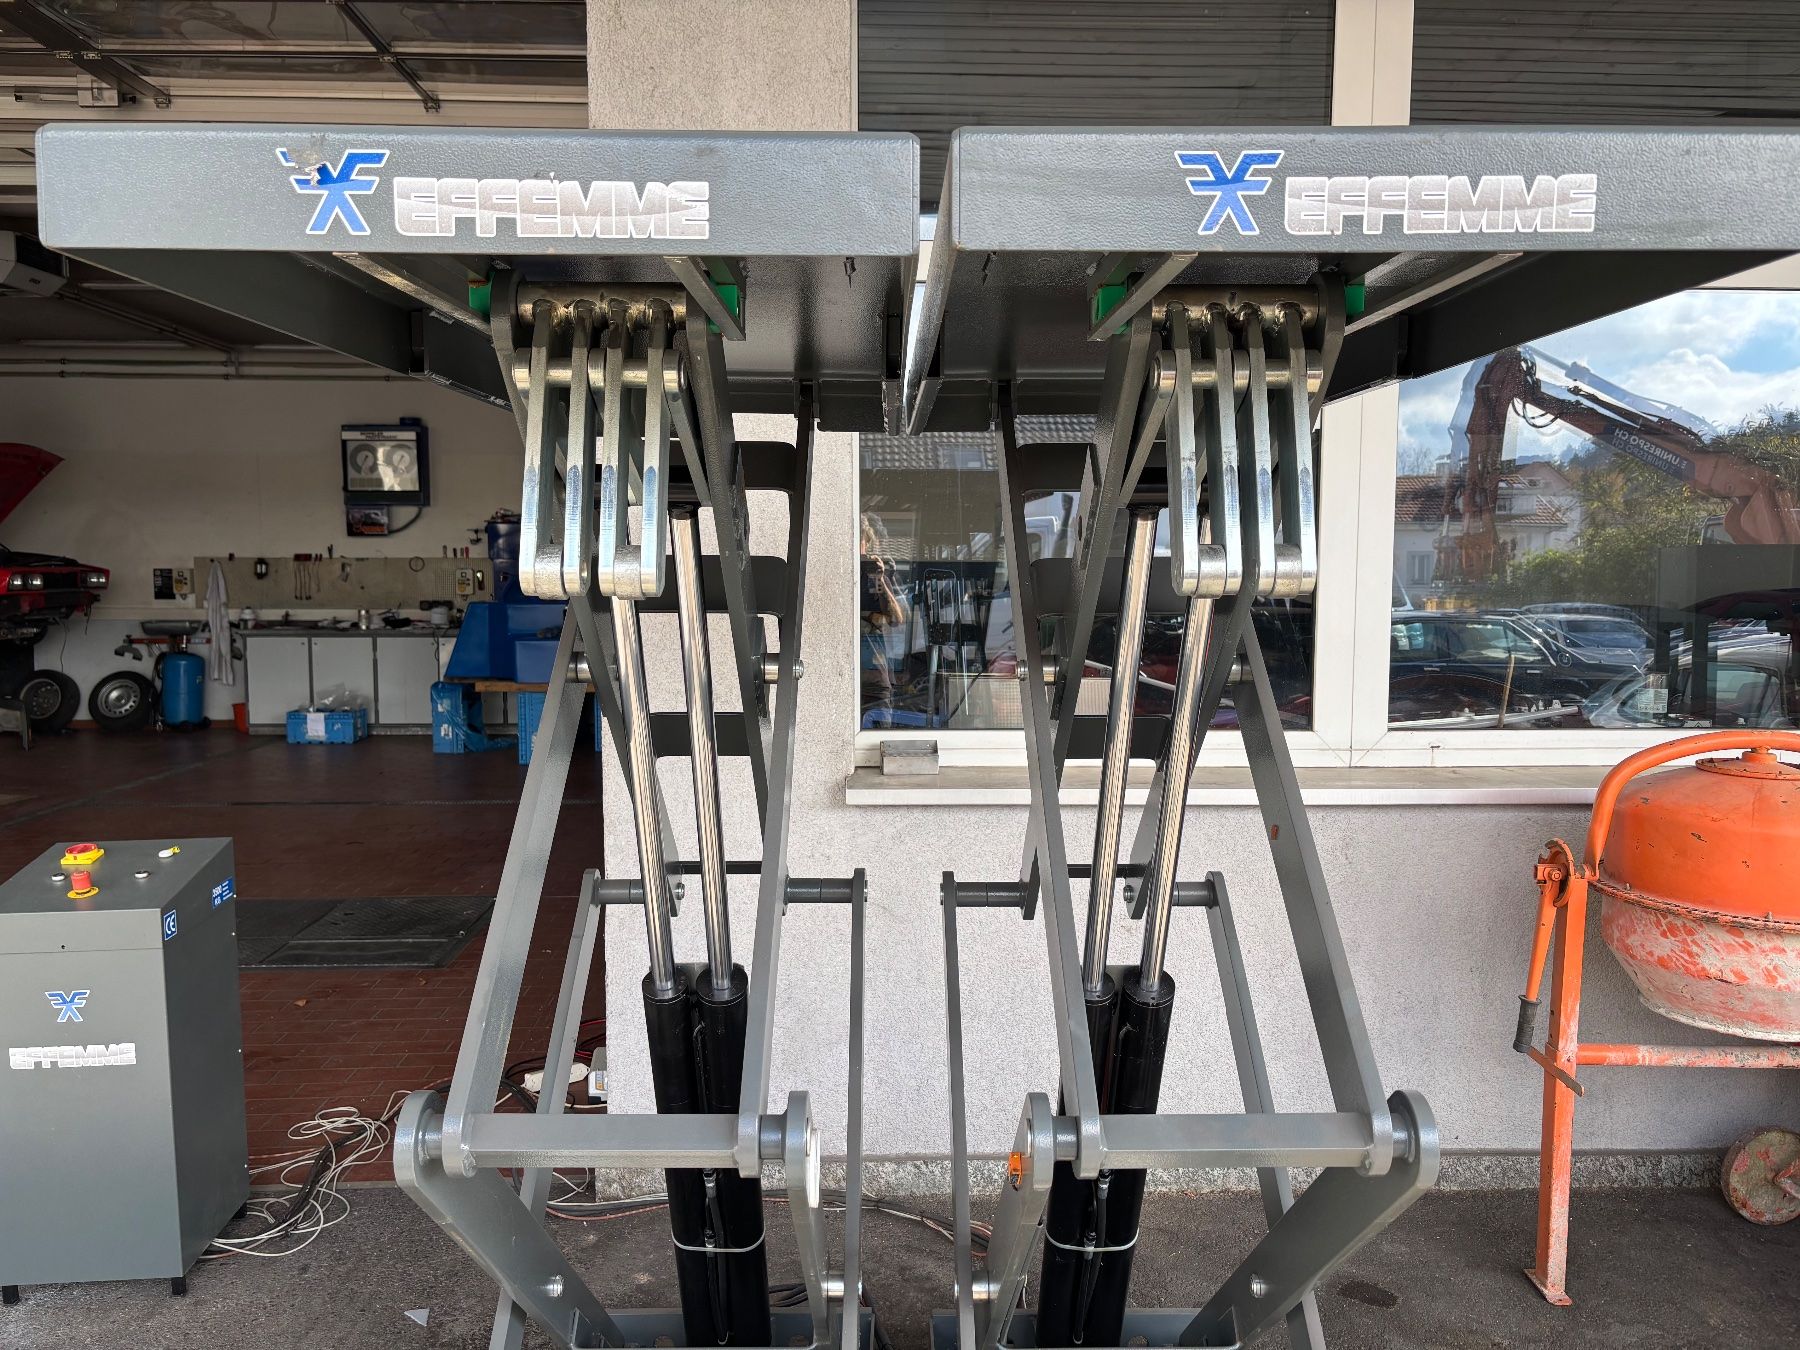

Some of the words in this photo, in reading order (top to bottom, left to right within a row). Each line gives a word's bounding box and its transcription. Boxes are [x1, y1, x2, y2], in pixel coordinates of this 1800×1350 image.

[394, 177, 709, 239] EFFEMME
[1285, 174, 1598, 235] EFFEMME
[165, 914, 176, 935] CE
[9, 1042, 137, 1070] EFFEMME
